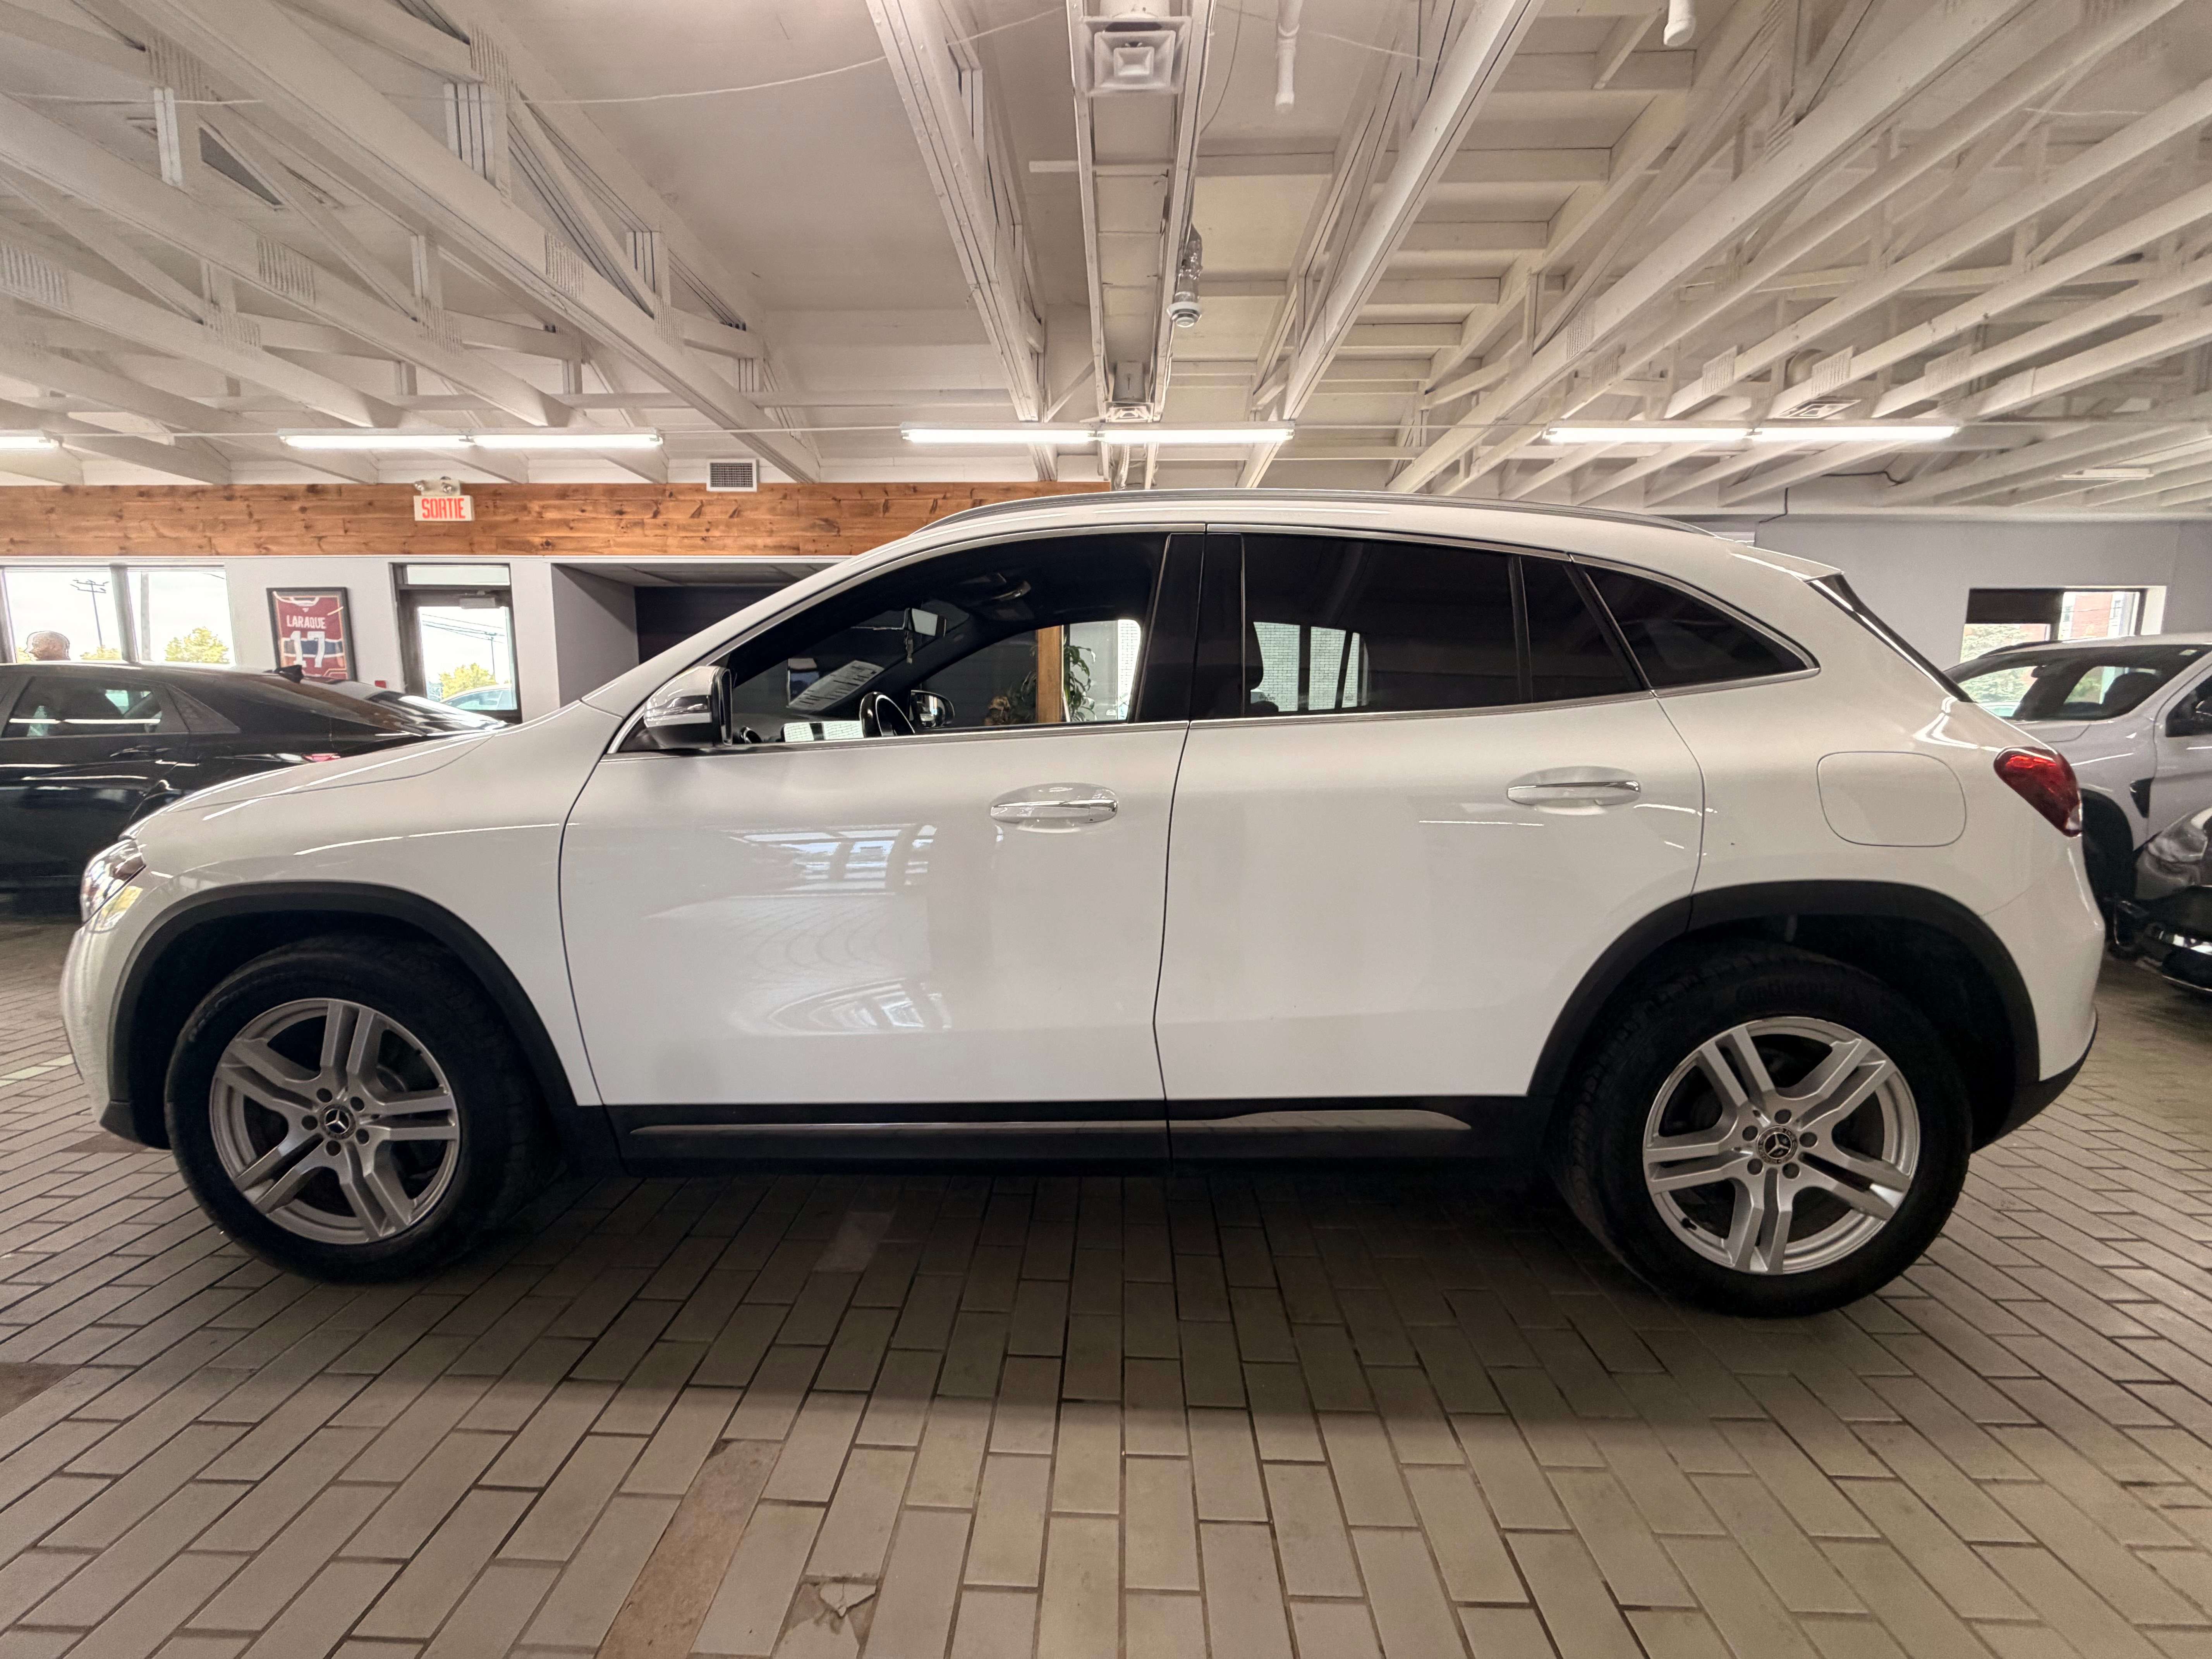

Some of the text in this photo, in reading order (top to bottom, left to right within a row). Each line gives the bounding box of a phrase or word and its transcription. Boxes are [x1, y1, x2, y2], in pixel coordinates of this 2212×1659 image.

[422, 498, 465, 519] SORTIE
[287, 615, 326, 629] LARAQUE
[290, 631, 325, 668] 17
